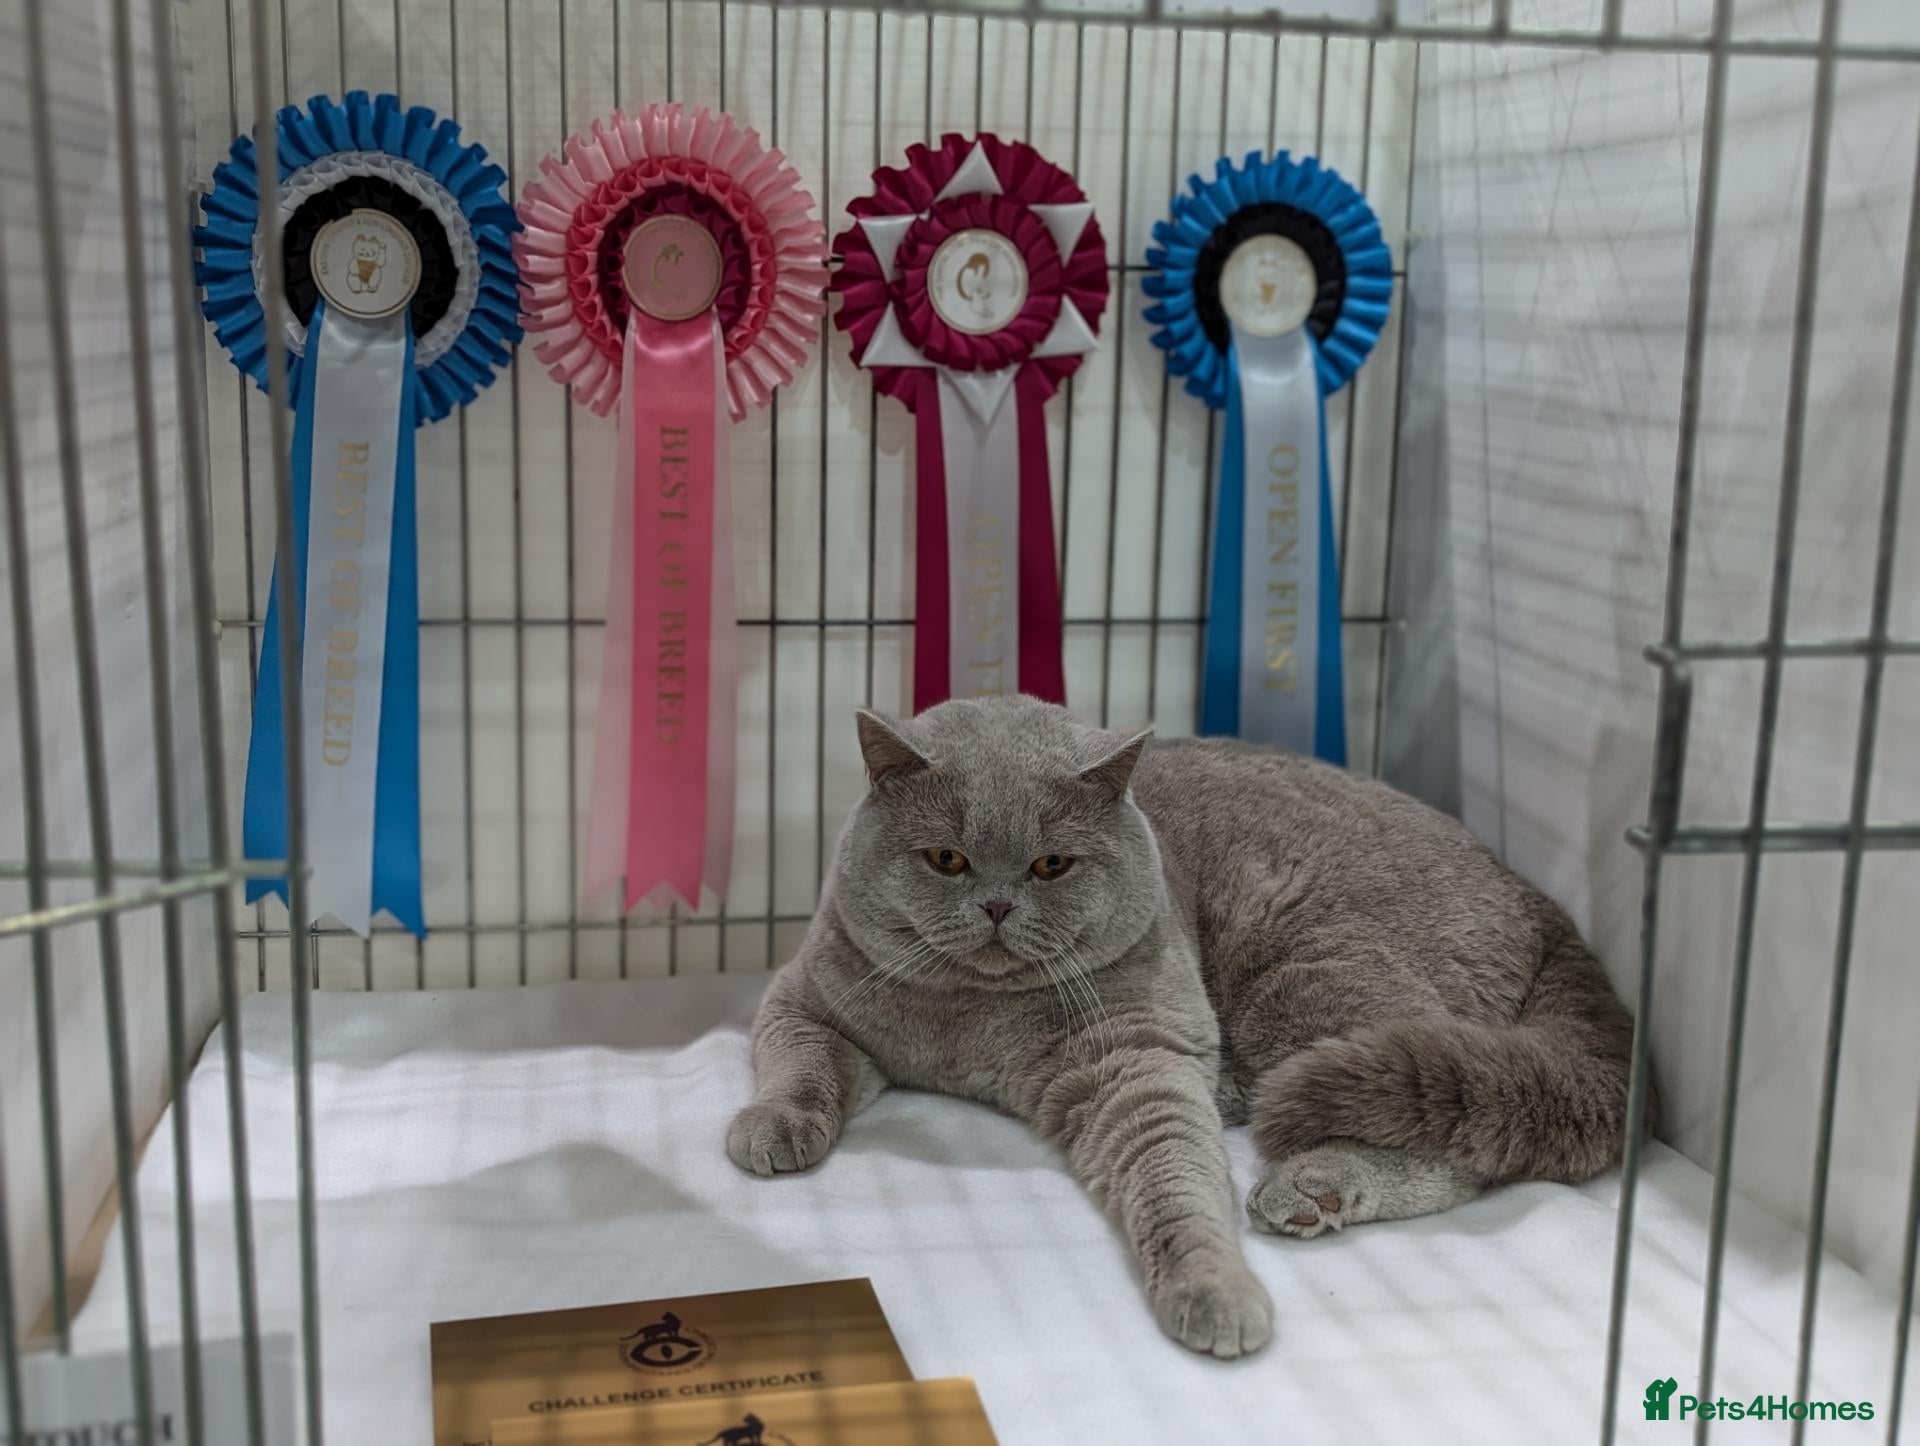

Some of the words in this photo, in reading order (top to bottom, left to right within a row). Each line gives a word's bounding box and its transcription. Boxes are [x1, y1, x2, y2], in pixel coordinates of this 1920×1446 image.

[334, 442, 370, 547] BEST
[659, 427, 690, 531] BEST
[1267, 442, 1299, 566] OPEN
[331, 560, 361, 618] OF
[657, 542, 689, 598] OF
[968, 514, 1004, 643] OPEN
[656, 611, 687, 746] BREED
[1264, 582, 1298, 697] FIRST
[322, 629, 358, 767] BREED
[528, 1387, 672, 1413] CHALLENGE
[679, 1371, 825, 1396] CERTIFICATE
